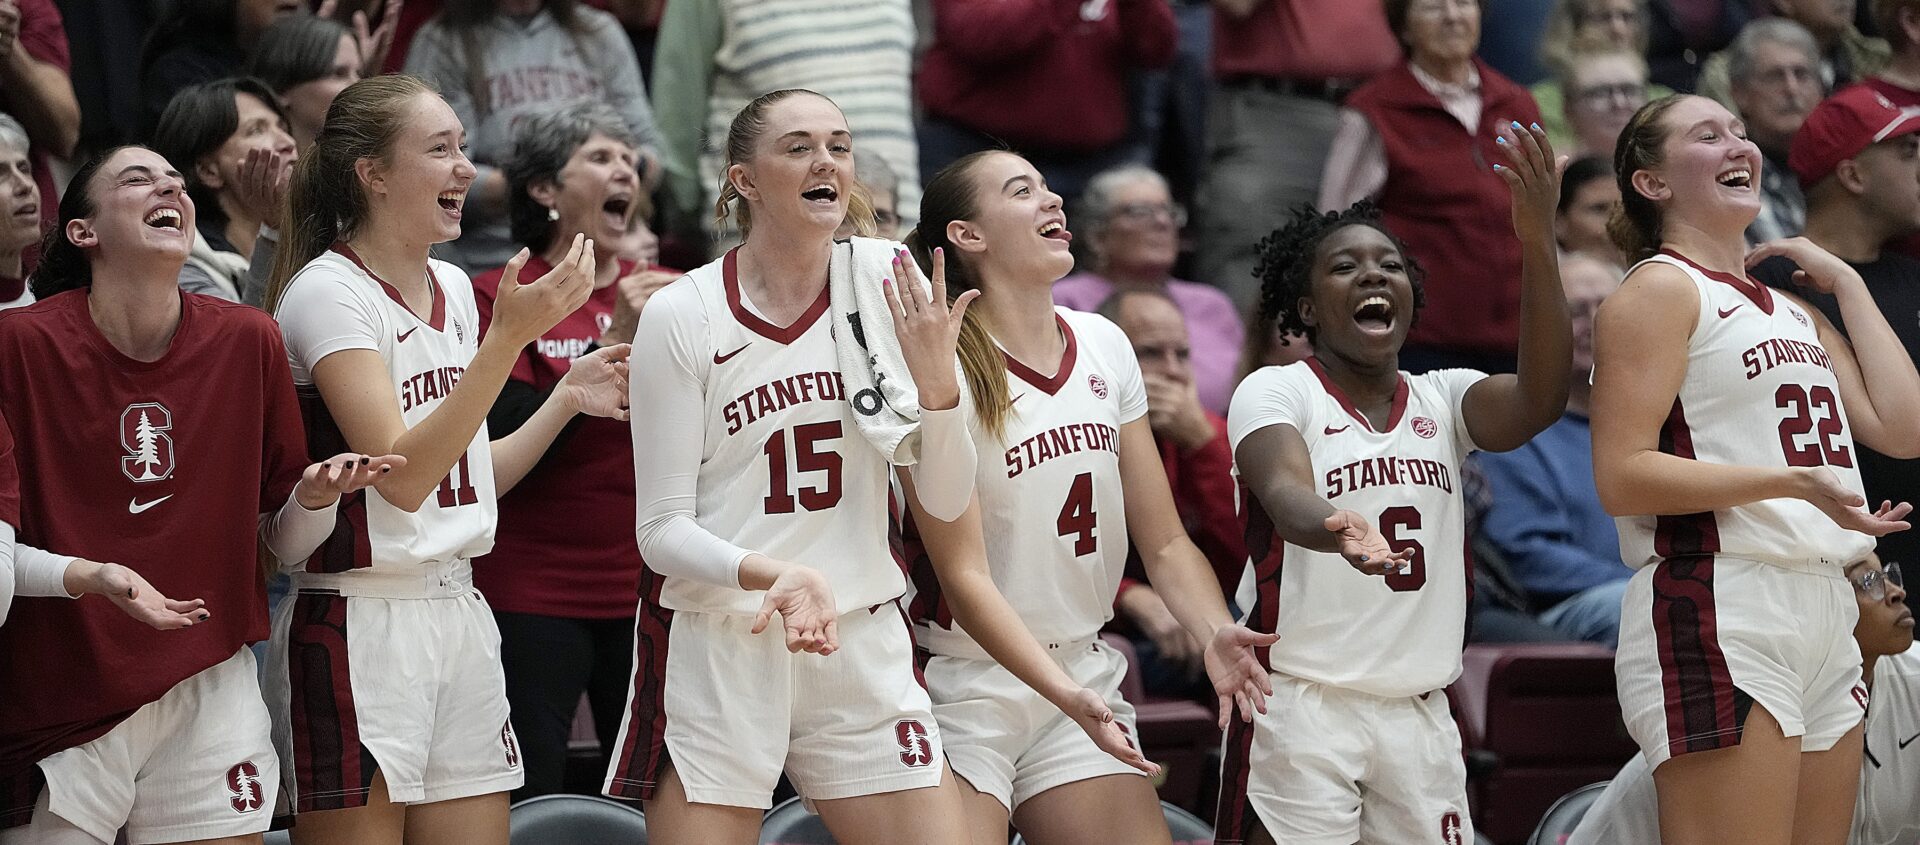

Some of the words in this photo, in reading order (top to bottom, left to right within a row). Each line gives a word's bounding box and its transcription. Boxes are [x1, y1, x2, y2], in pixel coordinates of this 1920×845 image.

[1742, 338, 1833, 380] STANFOR
[1004, 422, 1119, 479] STANFORD
[1775, 383, 1853, 469] 22
[763, 420, 844, 515] 15
[1326, 456, 1453, 500] STANFORD
[1056, 472, 1098, 558] 4
